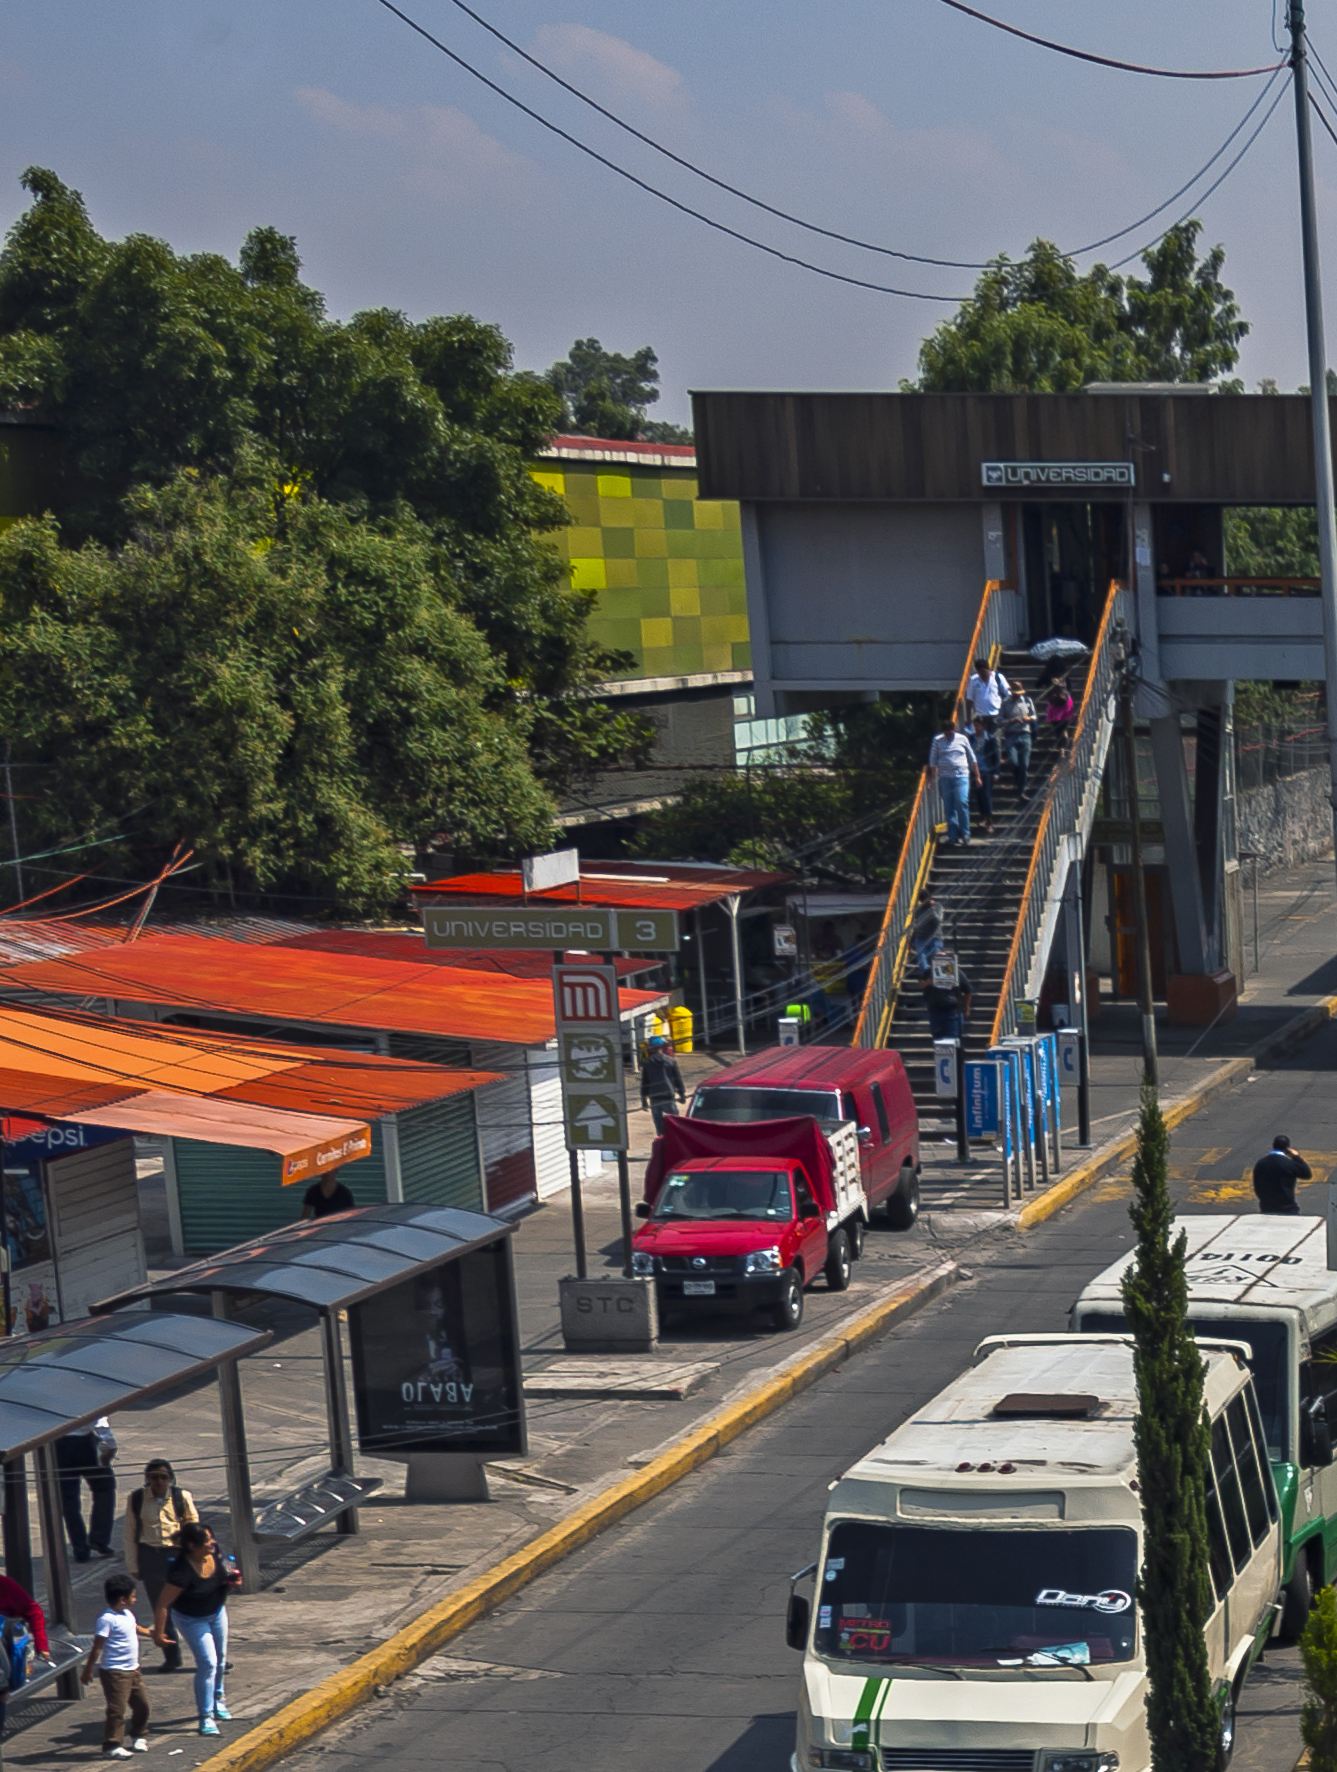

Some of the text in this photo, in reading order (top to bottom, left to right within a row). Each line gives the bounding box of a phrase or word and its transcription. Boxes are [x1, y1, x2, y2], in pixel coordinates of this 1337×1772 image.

[1007, 467, 1129, 482] UNIVERSIDAD
[433, 920, 656, 941] UNIVERSIDAD 3
[28, 1125, 87, 1149] epsi
[577, 1297, 634, 1314] STC
[839, 1618, 890, 1629] METRO
[849, 1633, 890, 1652] CU
